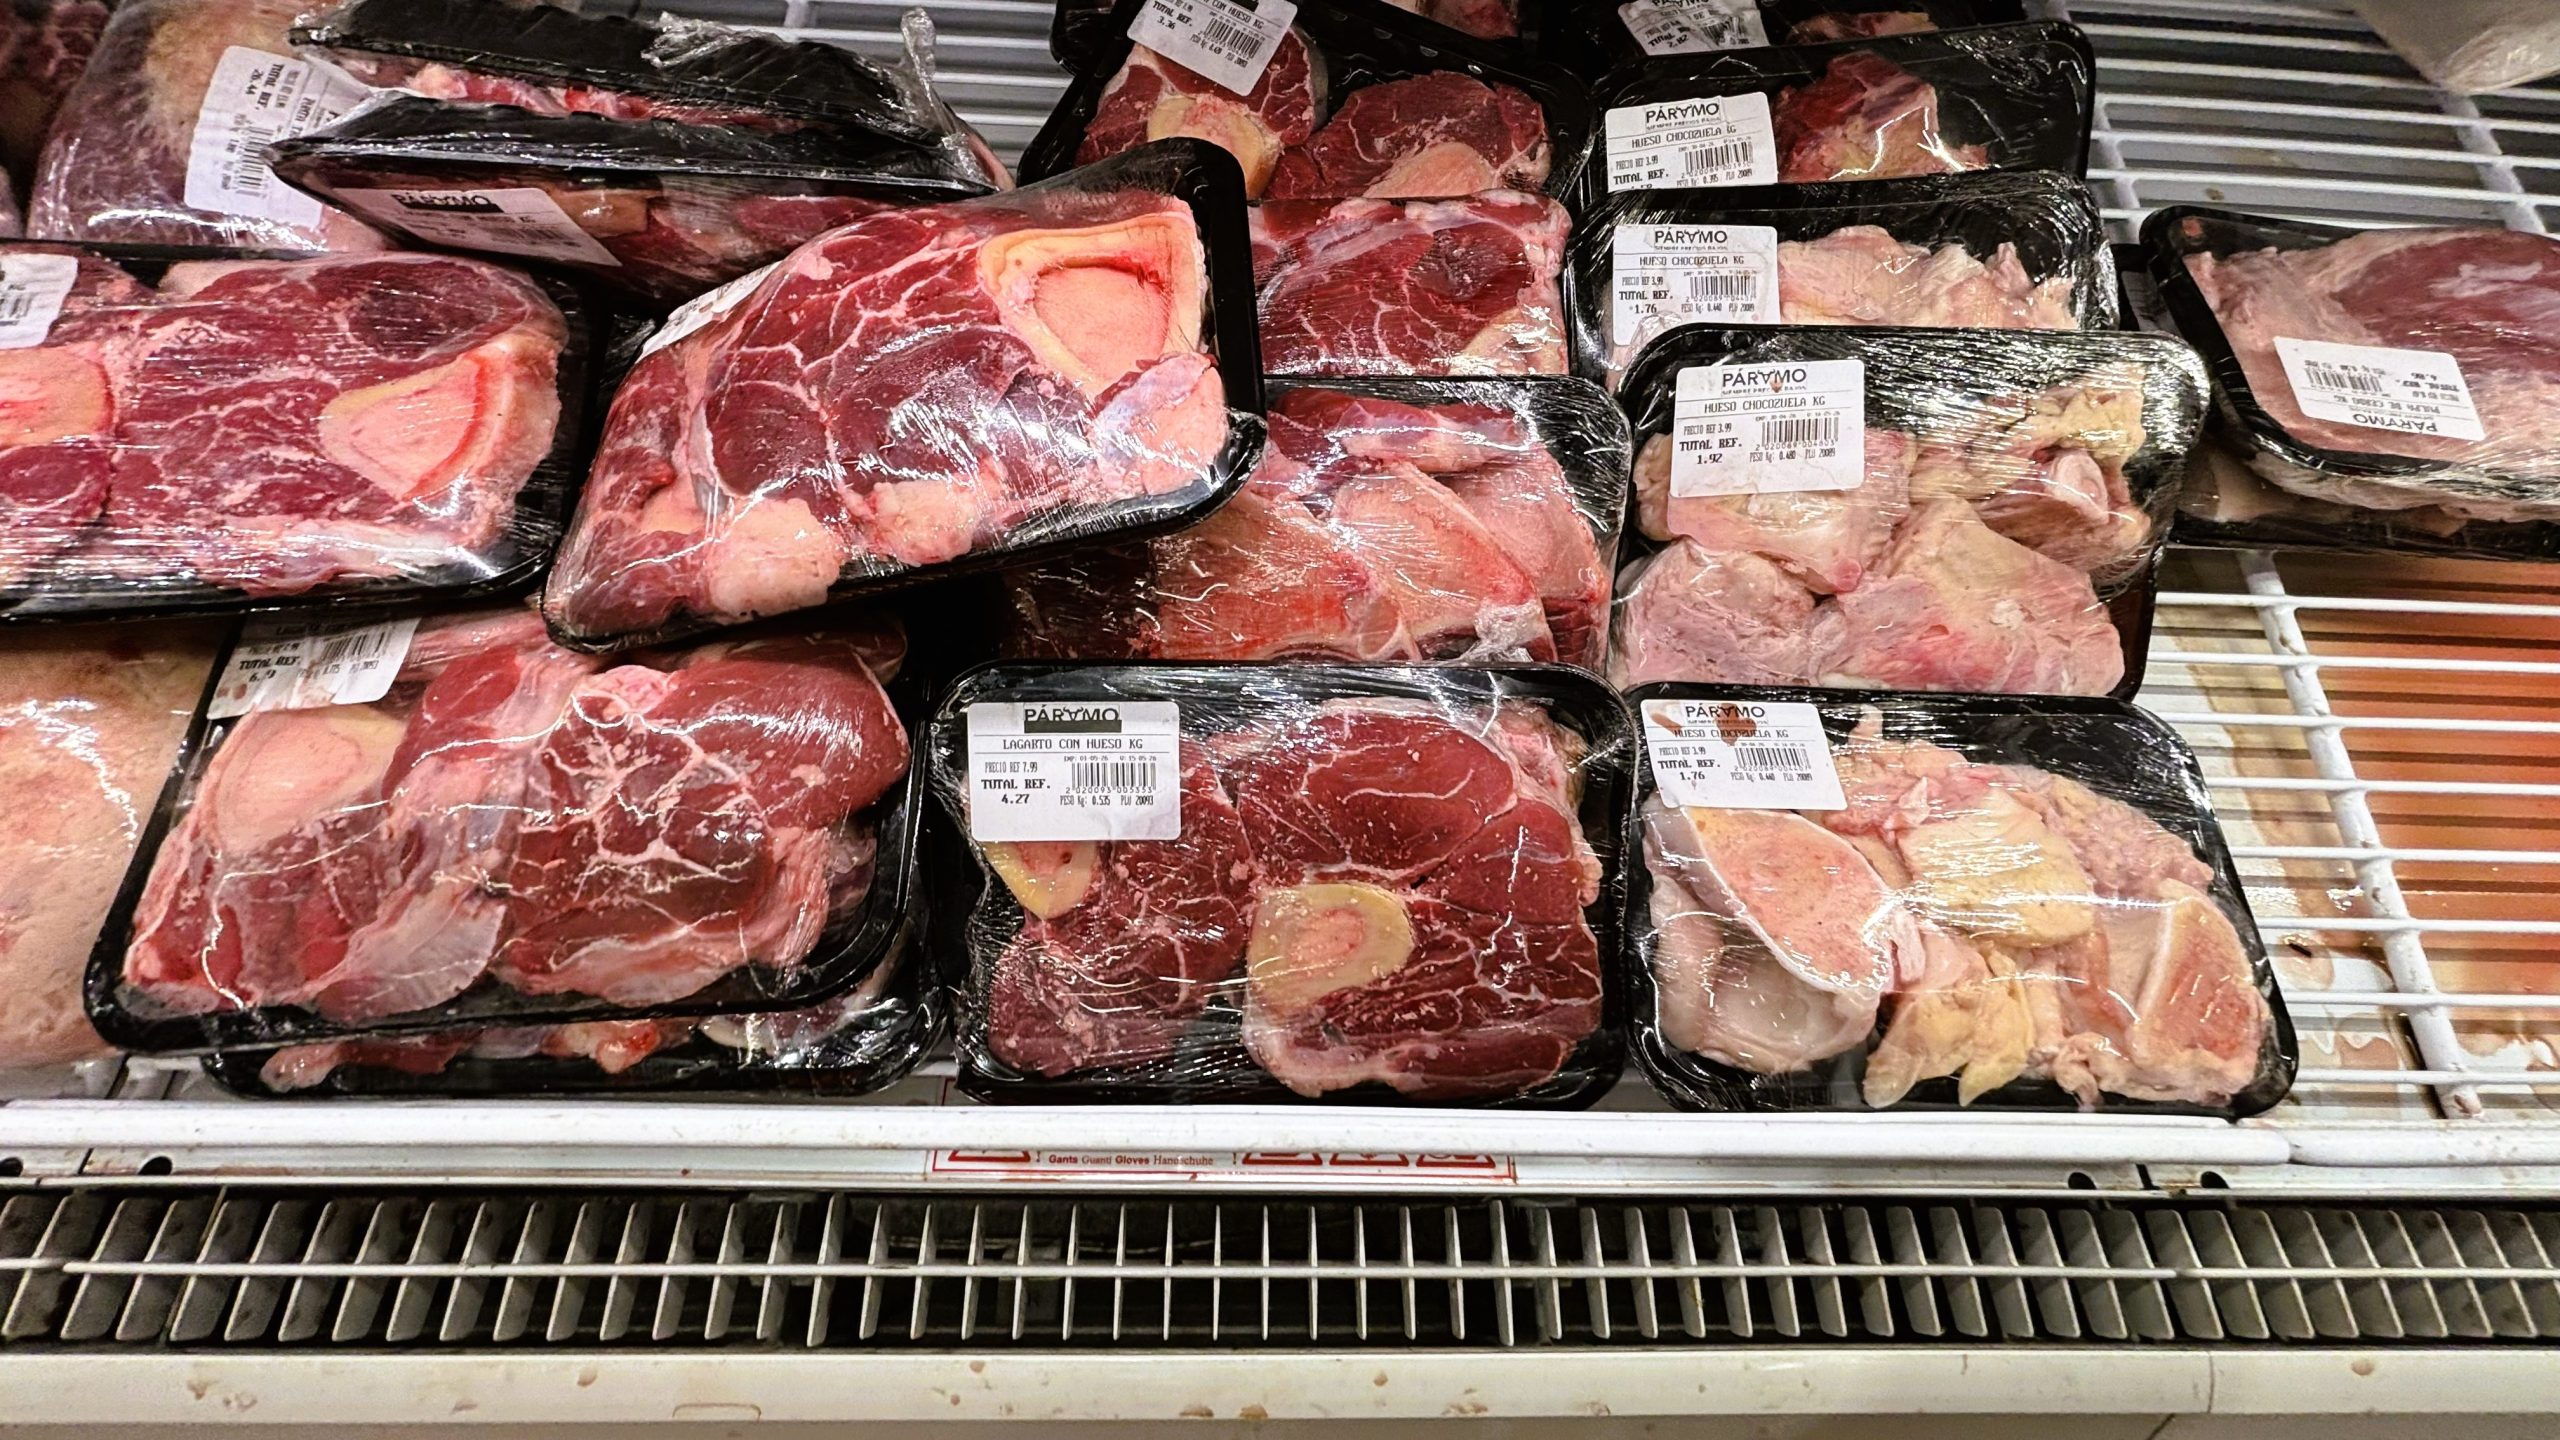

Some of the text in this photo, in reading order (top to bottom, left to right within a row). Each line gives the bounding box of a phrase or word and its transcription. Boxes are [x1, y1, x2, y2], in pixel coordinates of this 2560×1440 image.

[1228, 7, 1251, 23] HUESO
[1254, 19, 1264, 29] KG
[1646, 103, 1719, 123] PÁRAMO
[1632, 135, 1661, 148] HUESO
[1666, 128, 1721, 142] CHOCOZUELA
[1613, 169, 1668, 185] TOTAL REF.
[1655, 227, 1727, 243] PÁRAMO
[1640, 256, 1743, 265] HUESO CHOCOZUELA KG
[1652, 276, 1663, 285] 3.99
[1619, 290, 1673, 300] TOTAL REF.
[1635, 304, 1656, 313] 1.76
[1722, 368, 1806, 387] PÁRAMO
[1704, 396, 1825, 413] HUESO CHOCOZUELA KG
[2353, 414, 2438, 432] PÁRAMO
[1684, 423, 1731, 436] PRECIO REF 3.99
[1679, 438, 1742, 451] TOTAL REF.
[1697, 454, 1722, 464] 1.92
[1750, 451, 1763, 462] PESO
[1779, 450, 1796, 460] 0.480
[1805, 449, 1815, 459] PLU
[1819, 448, 1835, 457] 20089
[239, 658, 271, 669] TOTAL
[1025, 705, 1119, 721] PÁRAMO
[1685, 703, 1765, 718] PÁRAMO
[1674, 730, 1705, 738] HUESO
[1777, 730, 1788, 738] KG
[1003, 739, 1143, 749] LAGARTO CON HUESO KG
[1659, 747, 1680, 755] PRECIO
[1693, 747, 1706, 755] 3.99
[985, 762, 1038, 773] PRECIO REF 7.99
[1658, 760, 1692, 768] TOTAL
[1680, 772, 1705, 780] 1.76
[981, 779, 1050, 789] TOTAL REF.
[1001, 794, 1029, 804] 4.27
[1060, 796, 1153, 807] PESO Kg: 0.535 PLU 20093
[1048, 1155, 1213, 1166] Gants Guanti Gloves Handschuhe
